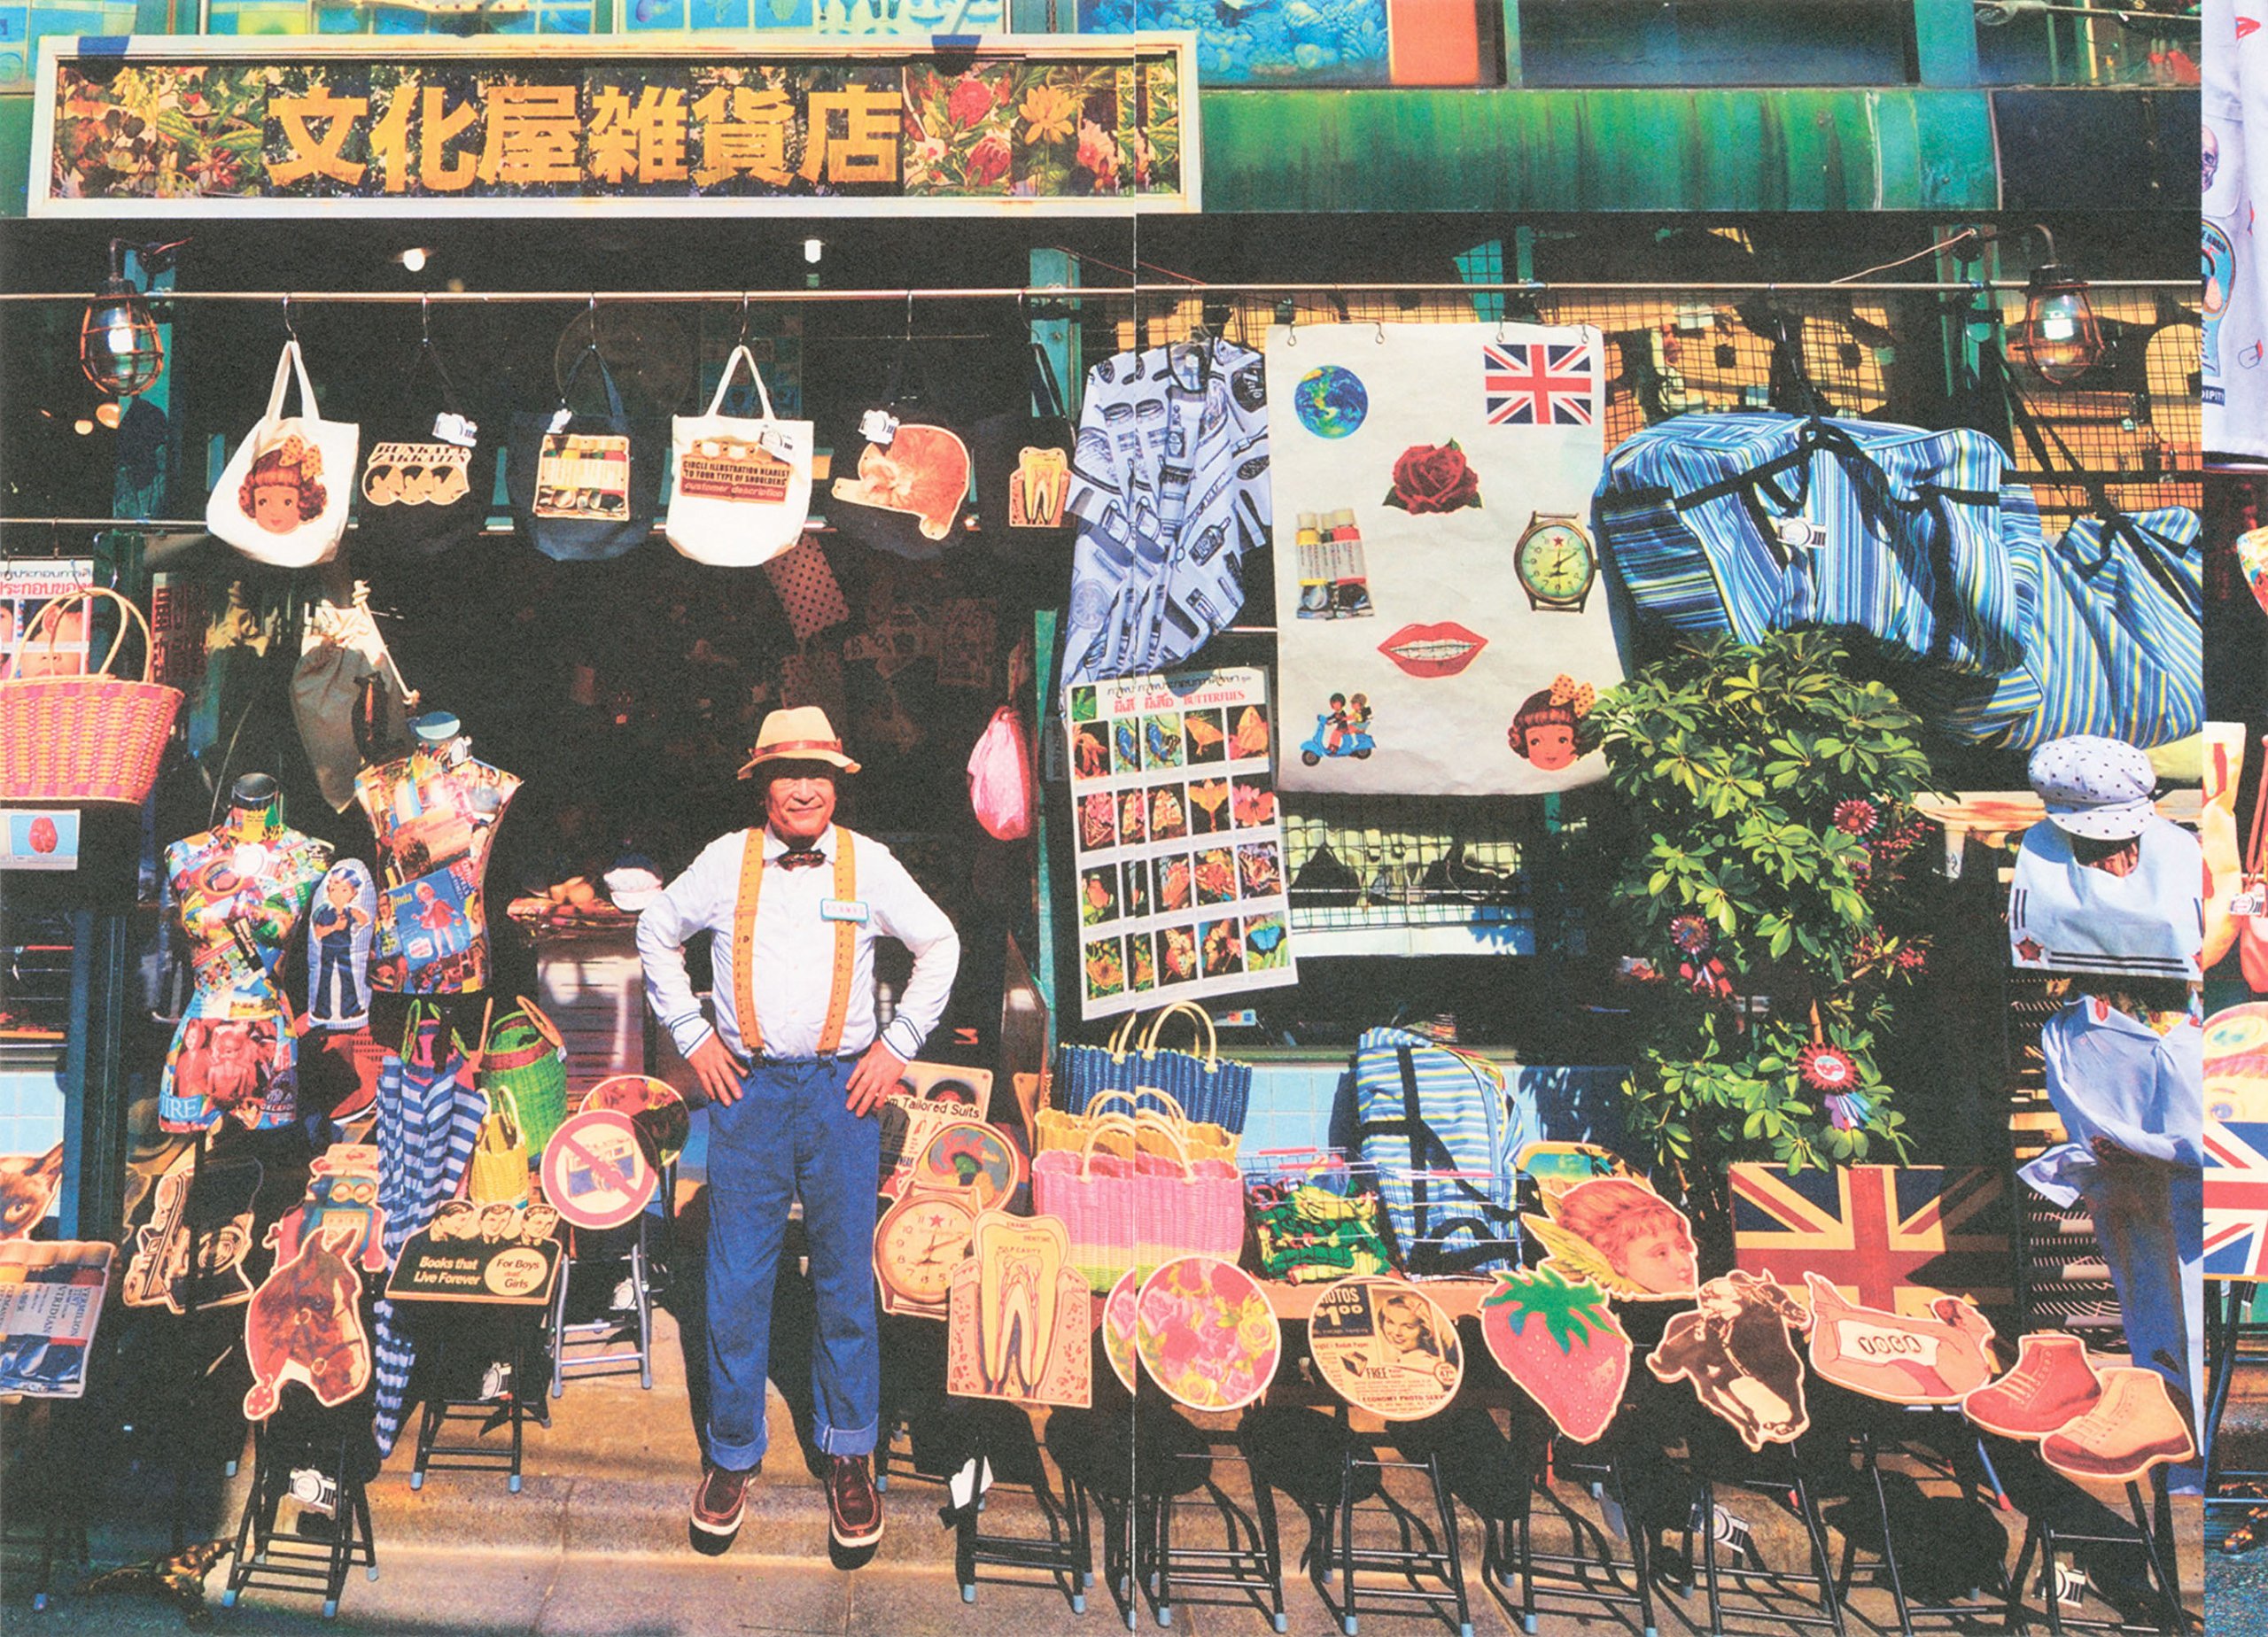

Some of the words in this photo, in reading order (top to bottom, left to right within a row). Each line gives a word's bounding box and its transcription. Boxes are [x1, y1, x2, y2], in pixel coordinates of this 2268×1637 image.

[268, 85, 902, 192] 文化屋雑貨店
[683, 461, 708, 469] CIRCLE
[710, 462, 758, 474] ILLUSTRATION
[760, 469, 790, 477] NEAREST
[684, 469, 694, 477] TO
[696, 470, 715, 479] YOUR
[717, 472, 734, 481] TYPE
[745, 475, 788, 486] SHOULDERS
[685, 482, 728, 493] customer
[731, 485, 784, 498] description
[1183, 689, 1246, 707] BUTTERFLIES
[902, 1097, 948, 1114] Tailored
[951, 1105, 980, 1119] Suits
[419, 1255, 454, 1268] Books
[454, 1257, 478, 1270] that
[496, 1258, 514, 1268] For
[515, 1259, 540, 1271] Boys
[414, 1271, 437, 1283] Live
[439, 1272, 482, 1285] Forever
[504, 1278, 529, 1289] Girls
[1366, 1367, 1388, 1379] FREE
